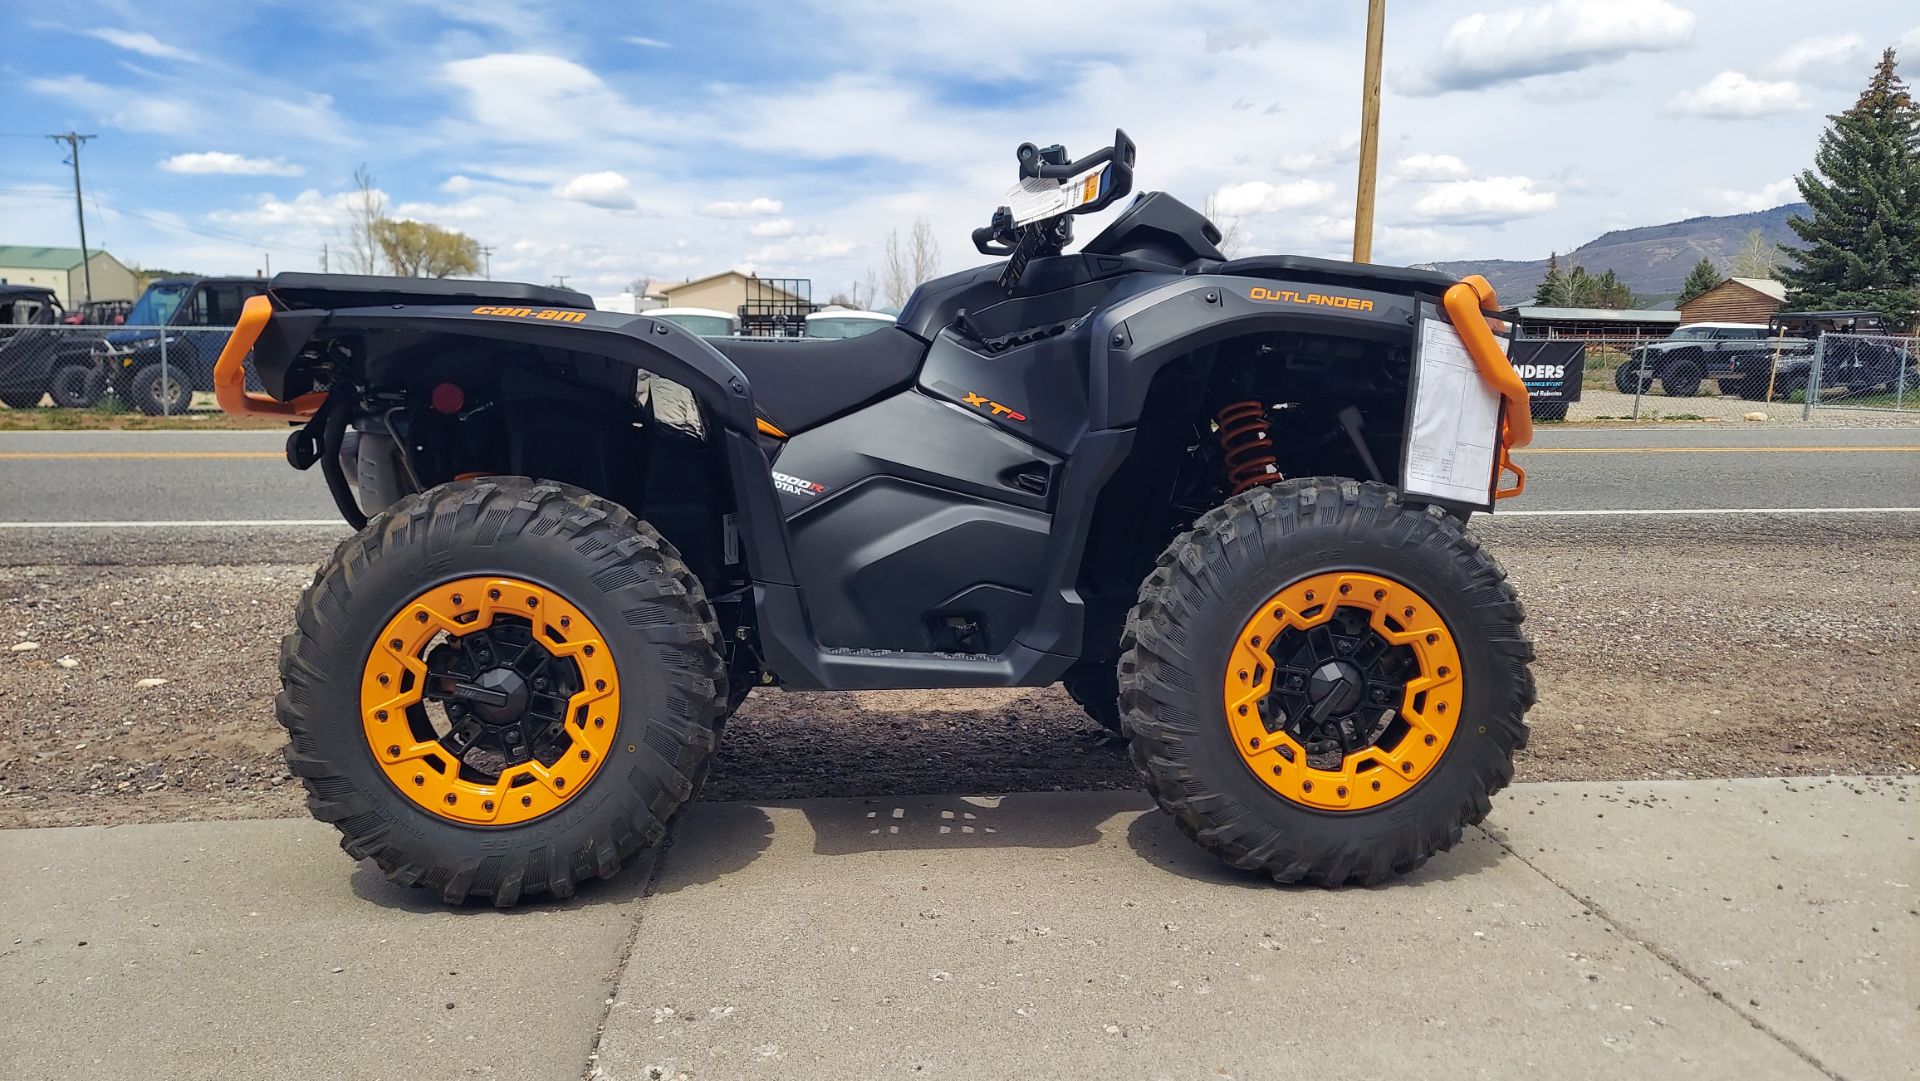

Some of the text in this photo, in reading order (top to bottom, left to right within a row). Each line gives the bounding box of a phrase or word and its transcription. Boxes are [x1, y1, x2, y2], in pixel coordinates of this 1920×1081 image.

[1249, 287, 1375, 312] OUTLANDER
[471, 306, 587, 323] can-am
[1513, 364, 1565, 379] NDERS
[774, 480, 801, 495] OTAX
